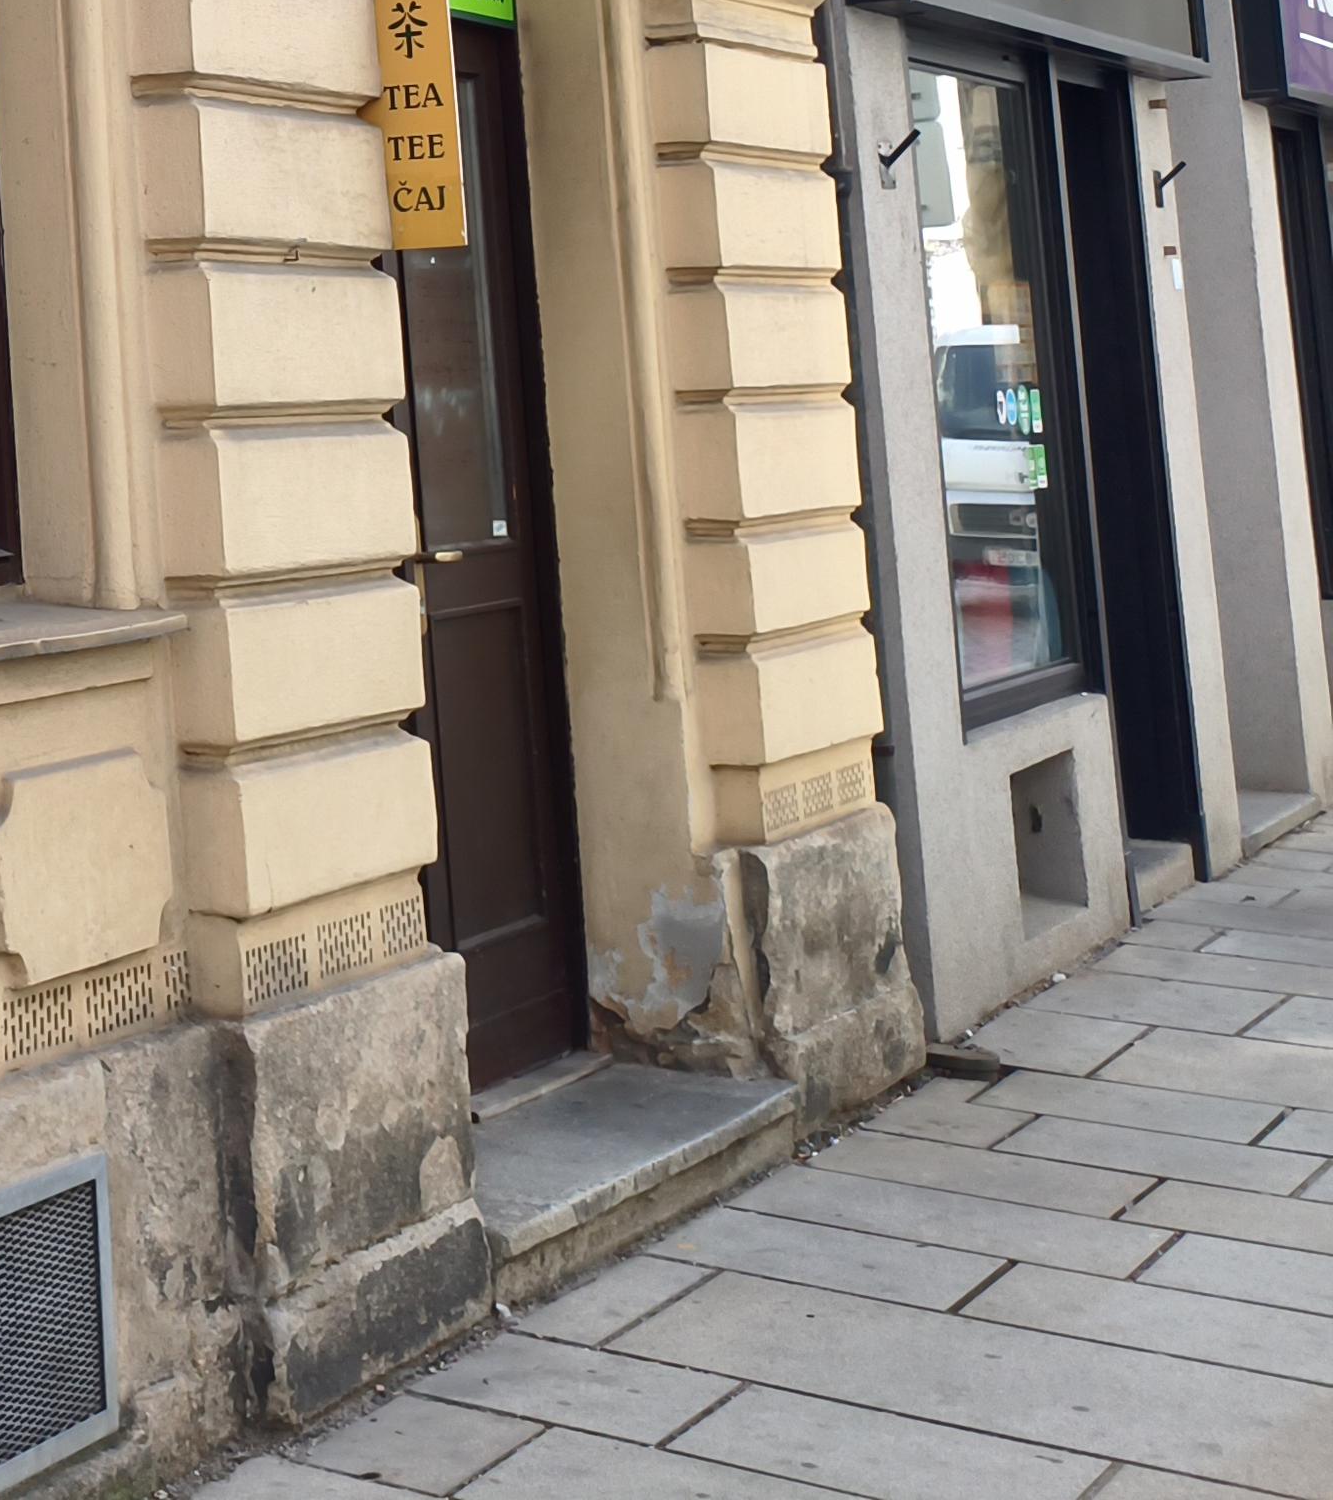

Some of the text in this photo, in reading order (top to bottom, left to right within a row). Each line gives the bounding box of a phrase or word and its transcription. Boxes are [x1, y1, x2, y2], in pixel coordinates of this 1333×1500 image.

[387, 0, 429, 60] 茶
[383, 82, 444, 111] TEA
[387, 133, 445, 162] TEE
[393, 180, 446, 213] ČAJ
